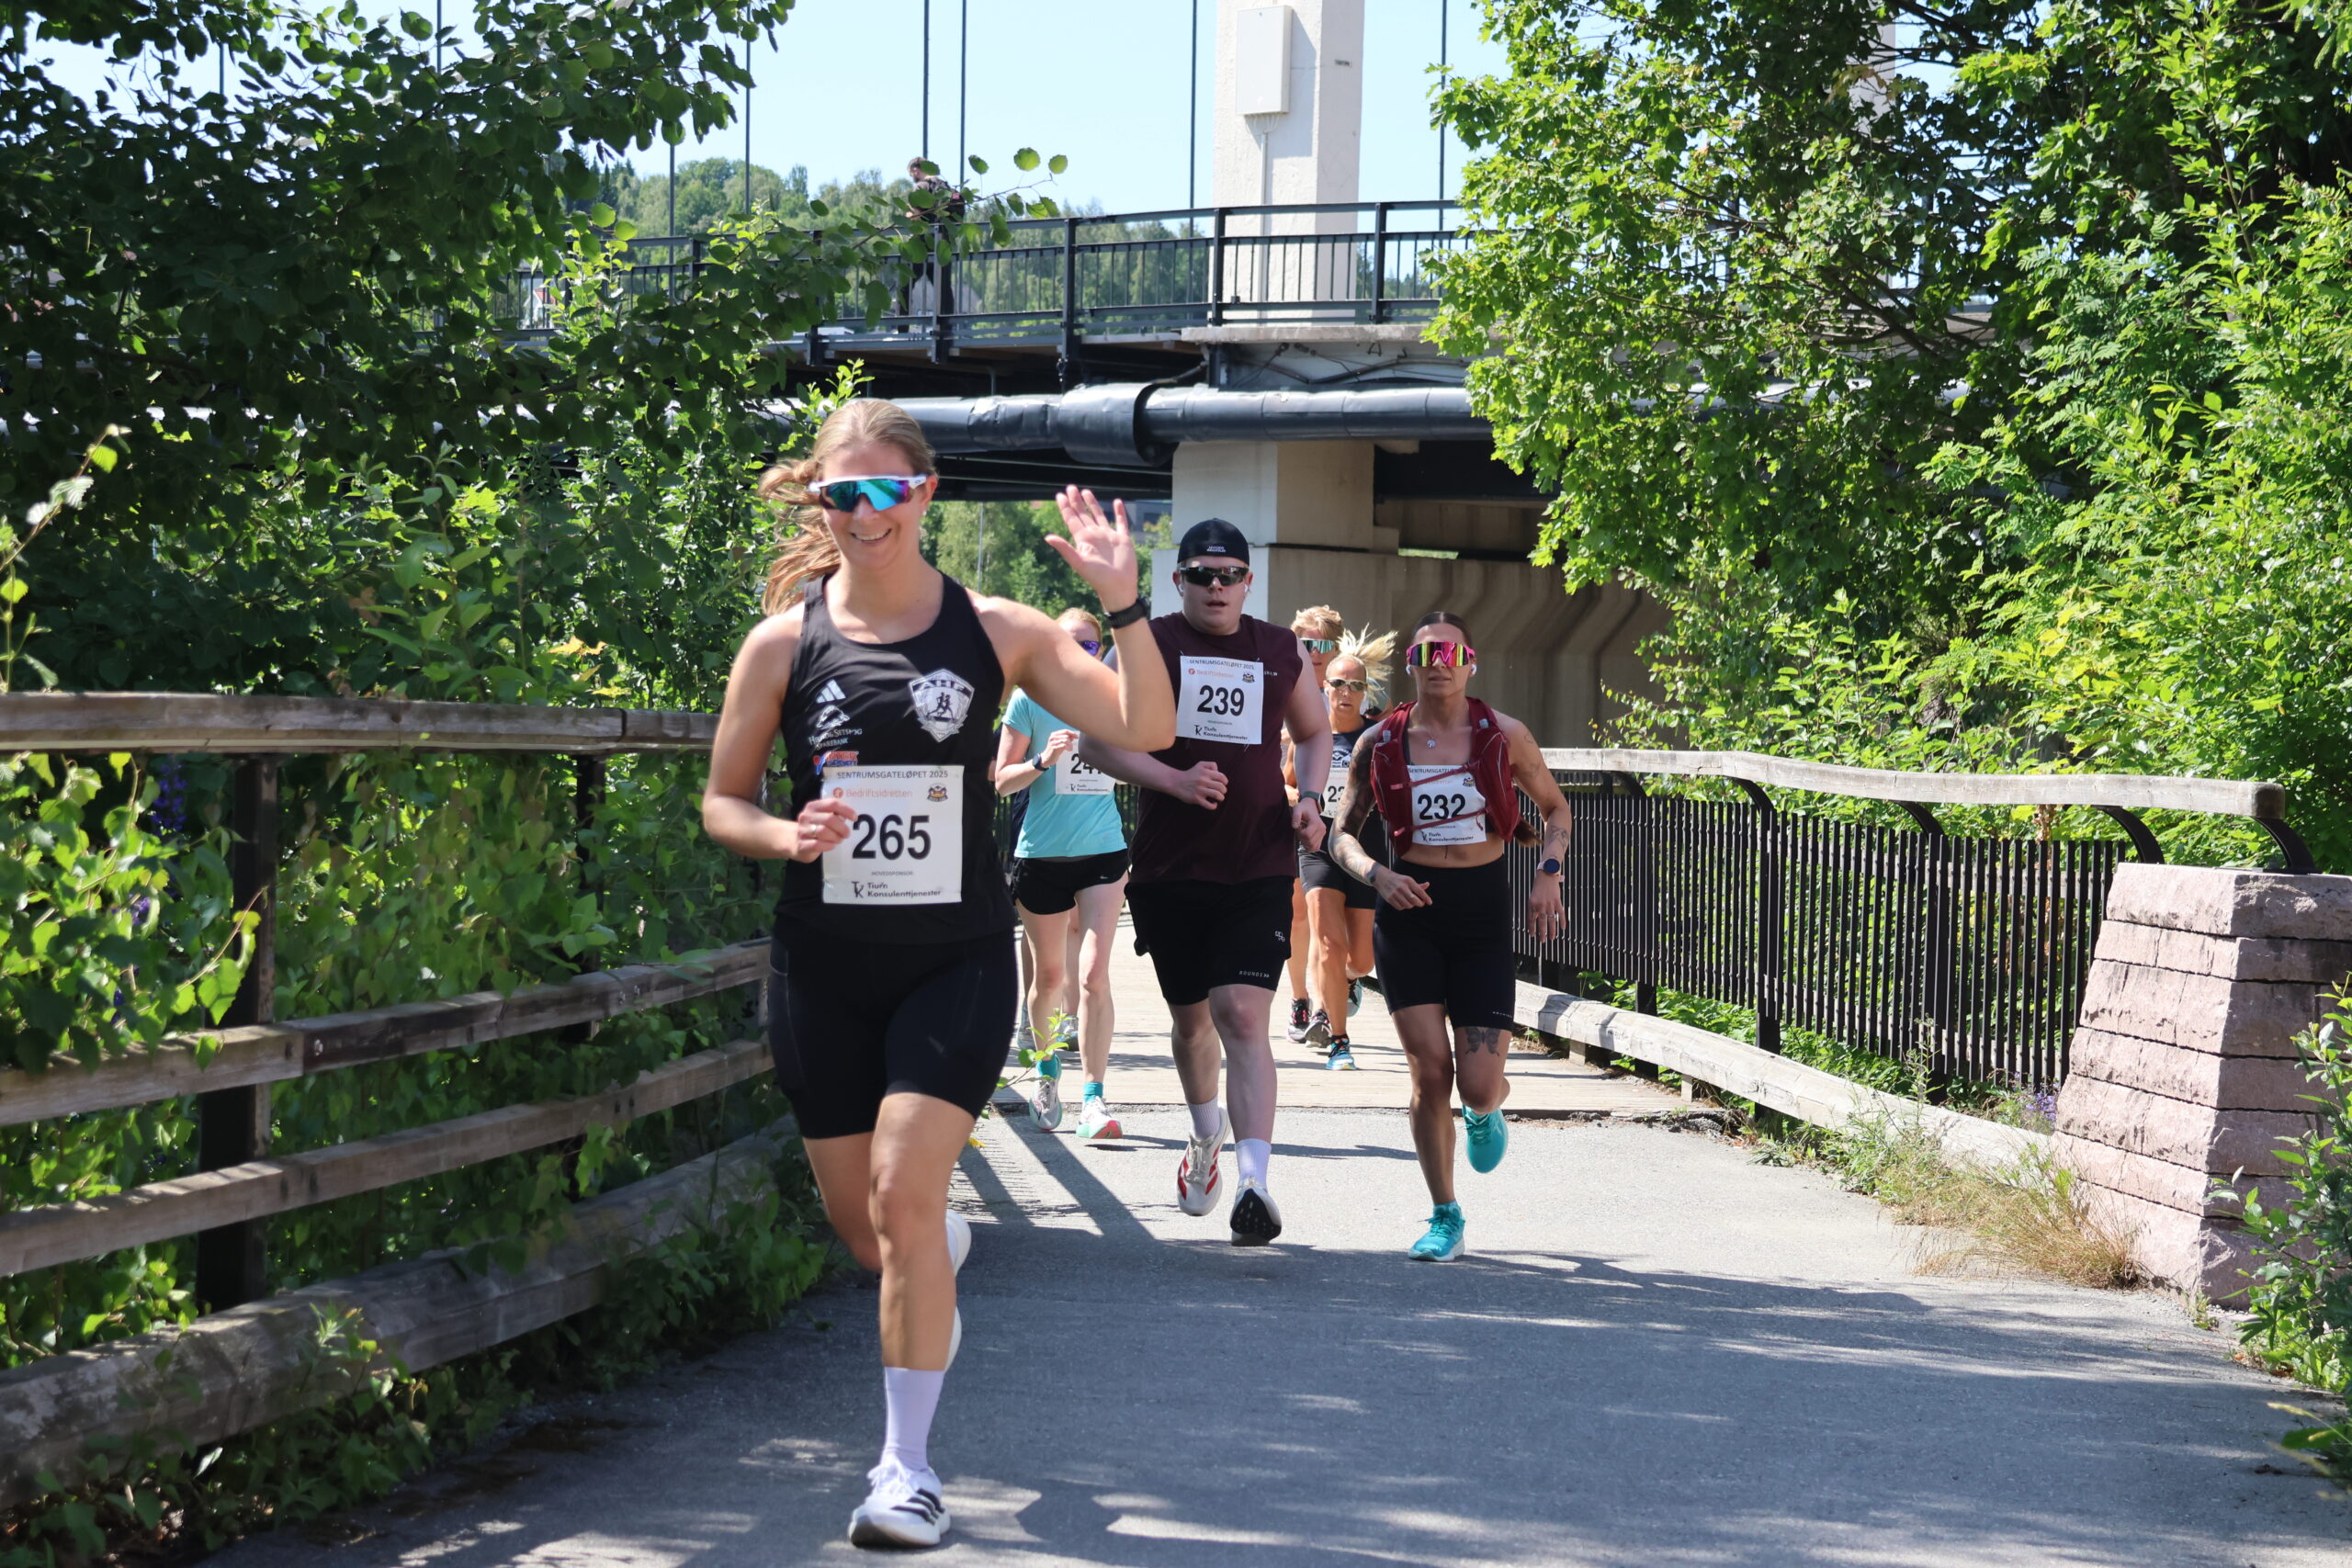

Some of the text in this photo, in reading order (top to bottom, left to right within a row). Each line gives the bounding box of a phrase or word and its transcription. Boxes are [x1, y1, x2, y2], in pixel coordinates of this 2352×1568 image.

[1197, 684, 1245, 716] 239
[1070, 753, 1102, 774] 24
[837, 771, 948, 780] SENTRUMSGATELØPET 2025
[1417, 794, 1466, 820] 232
[852, 814, 932, 861] 265
[867, 890, 942, 898] Konsulenttjenester
